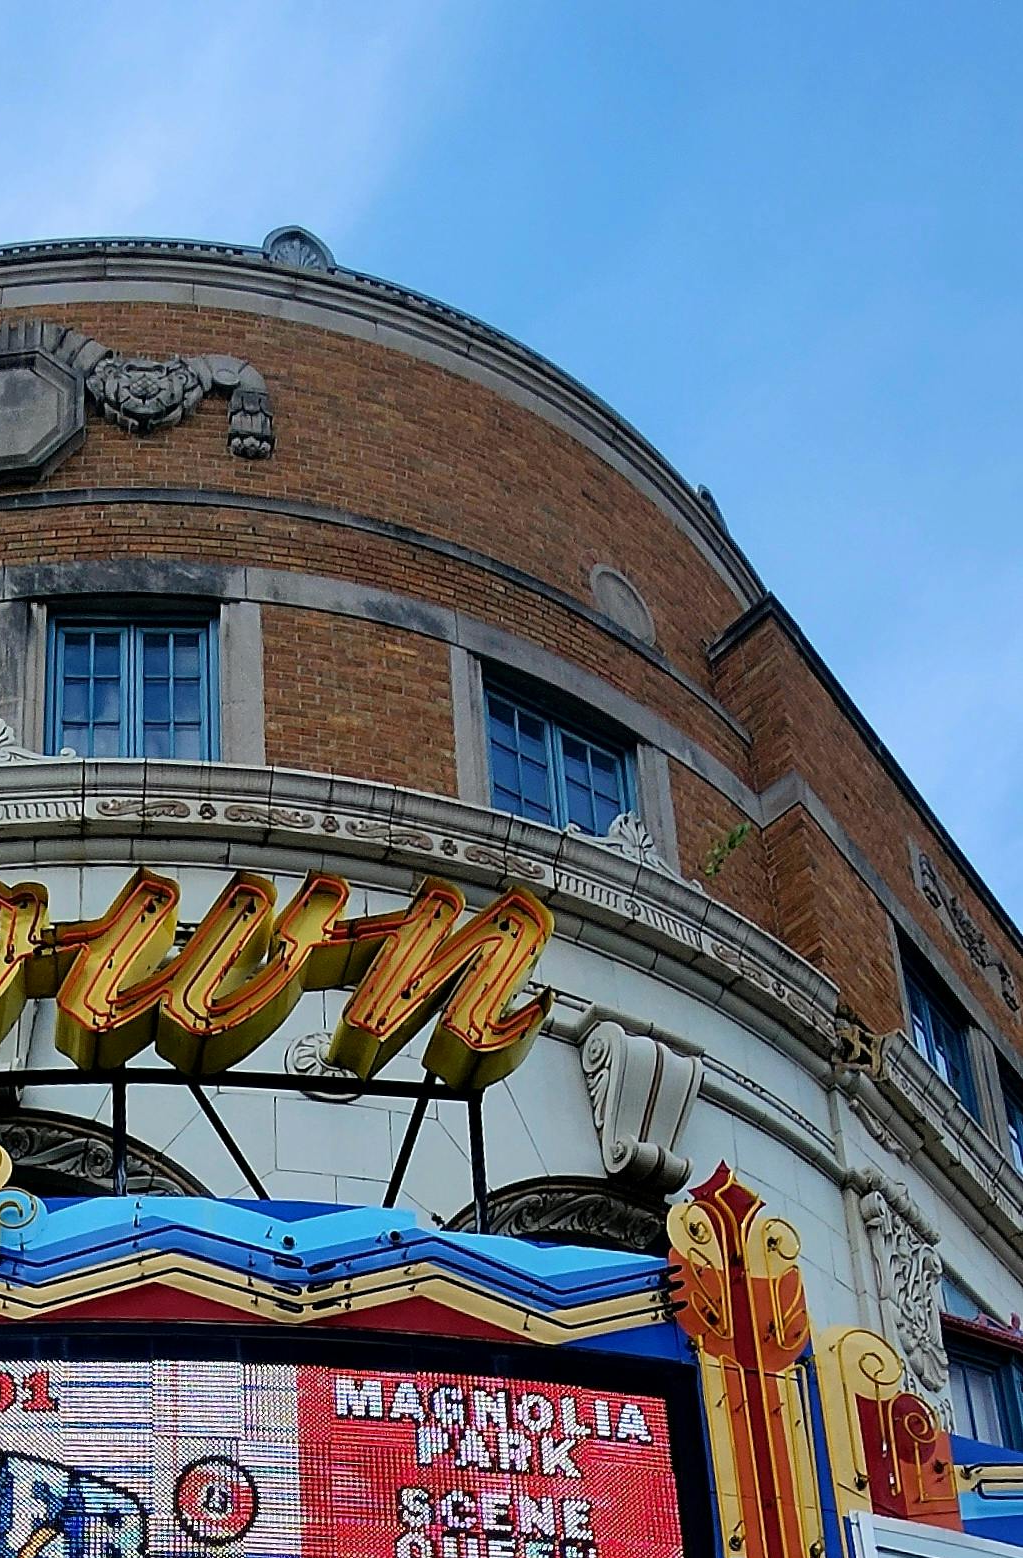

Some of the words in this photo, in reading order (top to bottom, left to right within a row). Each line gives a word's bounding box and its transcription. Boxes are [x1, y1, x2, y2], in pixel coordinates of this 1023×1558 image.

[333, 1374, 654, 1443] MAGNOLIA
[415, 1424, 583, 1480] PARK
[397, 1486, 596, 1543] SCENE
